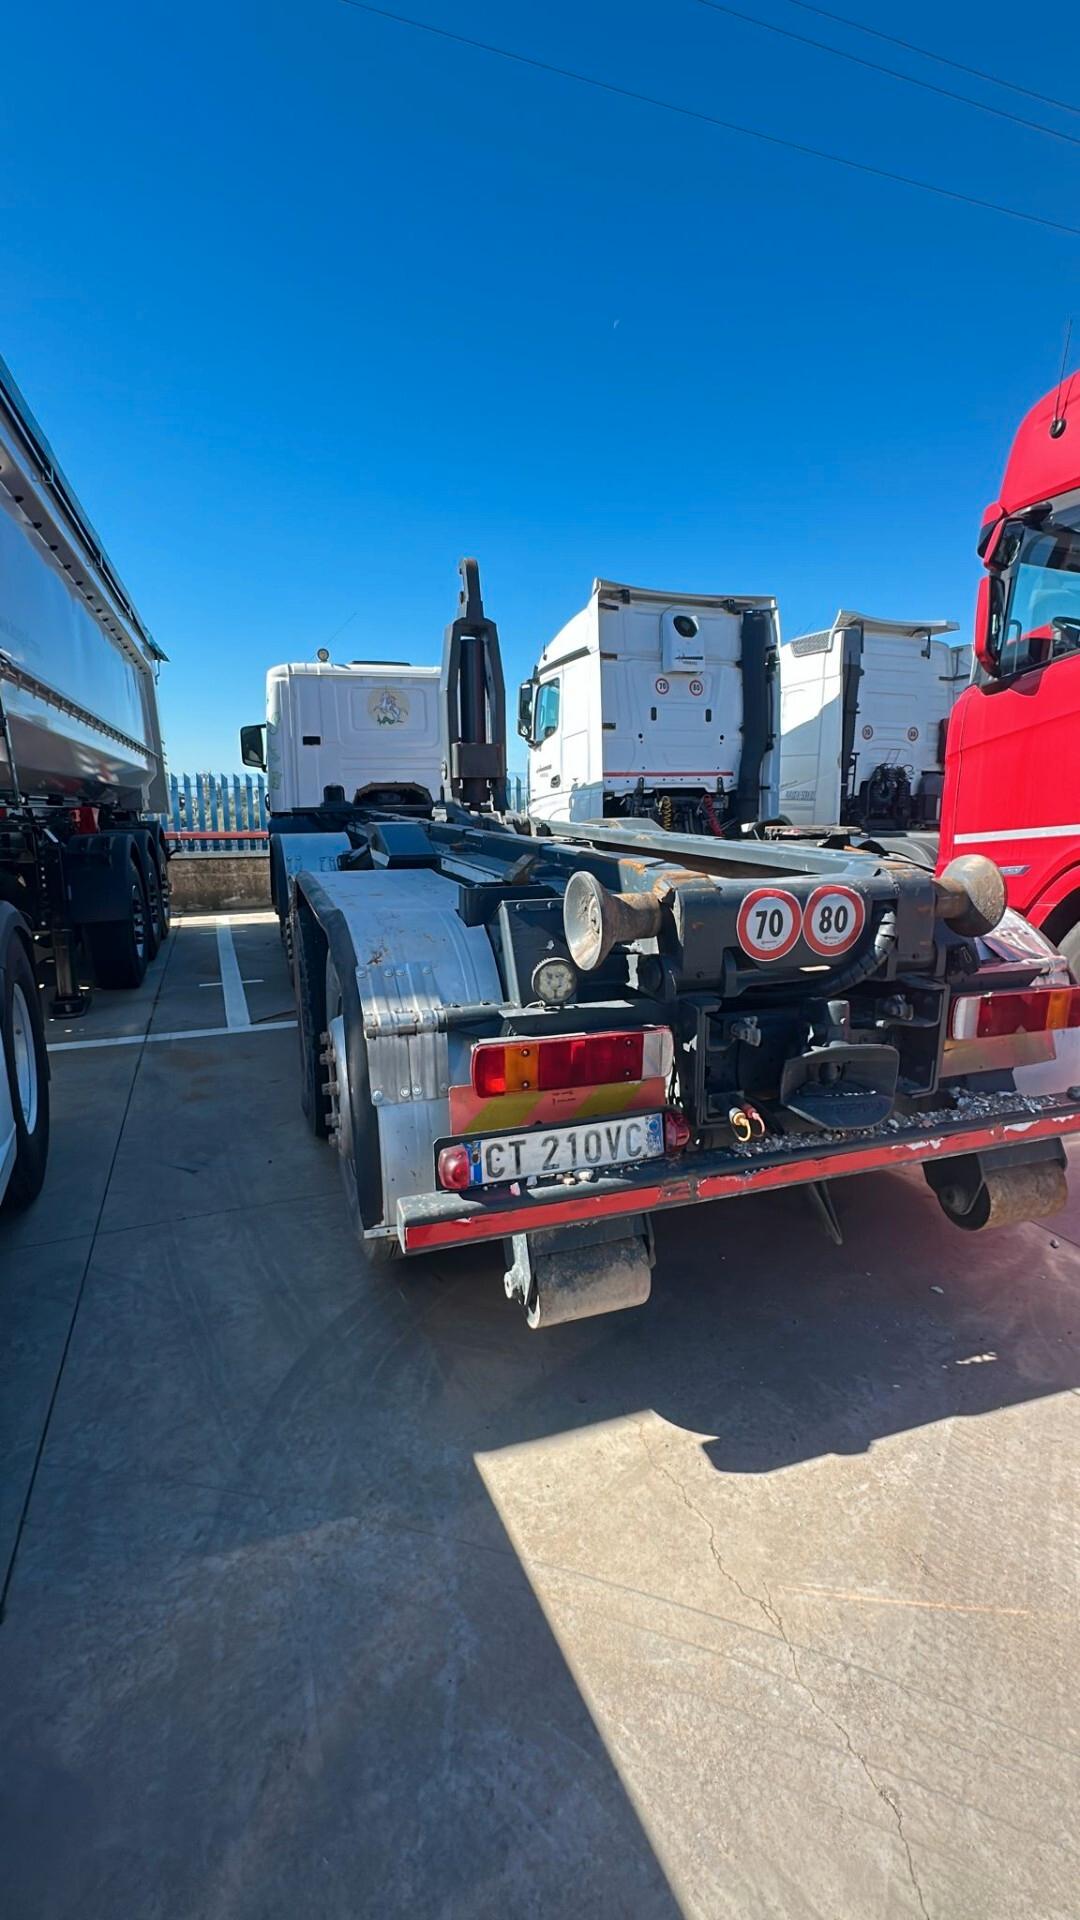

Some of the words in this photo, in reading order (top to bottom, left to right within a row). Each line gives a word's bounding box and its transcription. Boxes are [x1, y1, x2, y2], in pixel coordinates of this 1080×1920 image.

[755, 908, 784, 940] 70
[818, 905, 848, 934] 80
[485, 1139, 527, 1178] CT
[541, 1122, 643, 1171] 210VC
